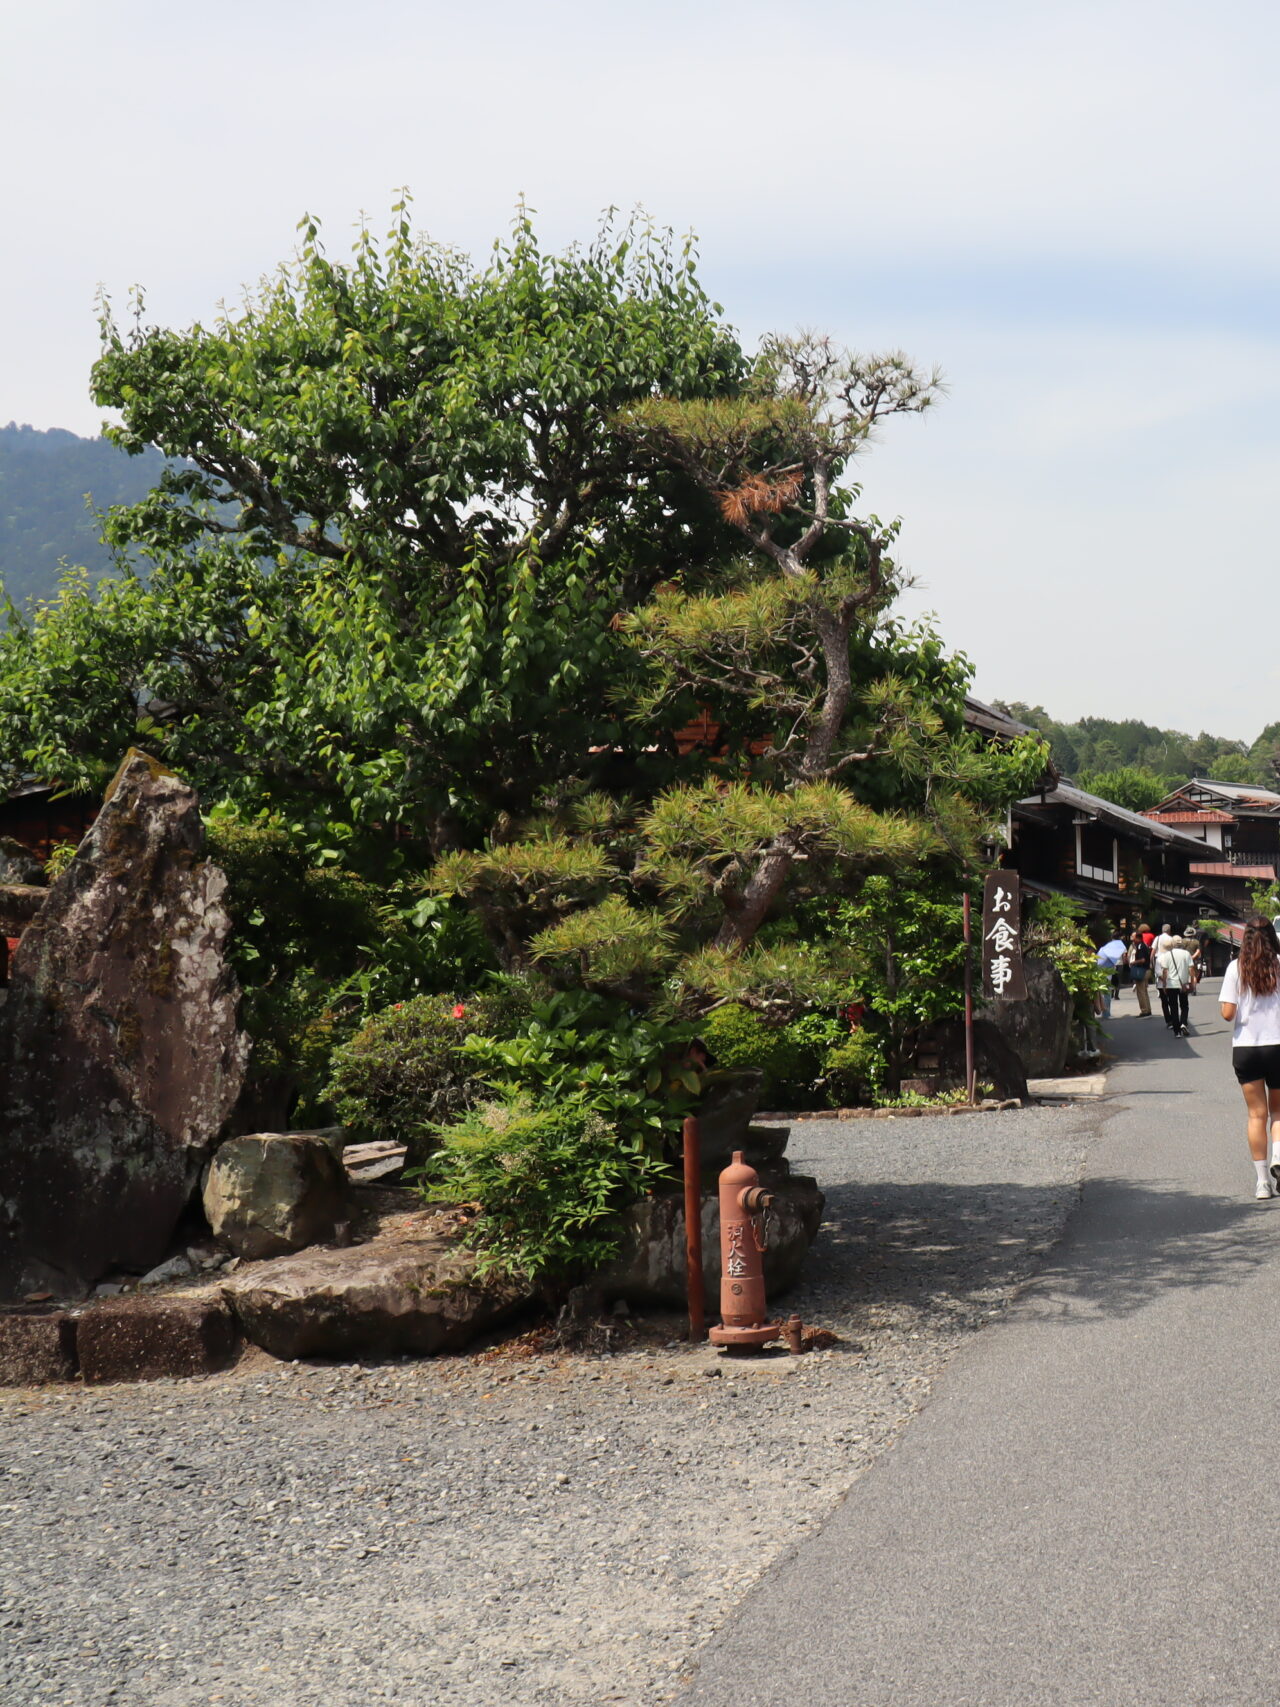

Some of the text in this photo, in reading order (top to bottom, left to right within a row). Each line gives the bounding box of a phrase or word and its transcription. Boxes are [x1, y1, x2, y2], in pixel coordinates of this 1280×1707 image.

[985, 886, 1018, 994] お食事
[727, 1226, 748, 1277] 消火栓
